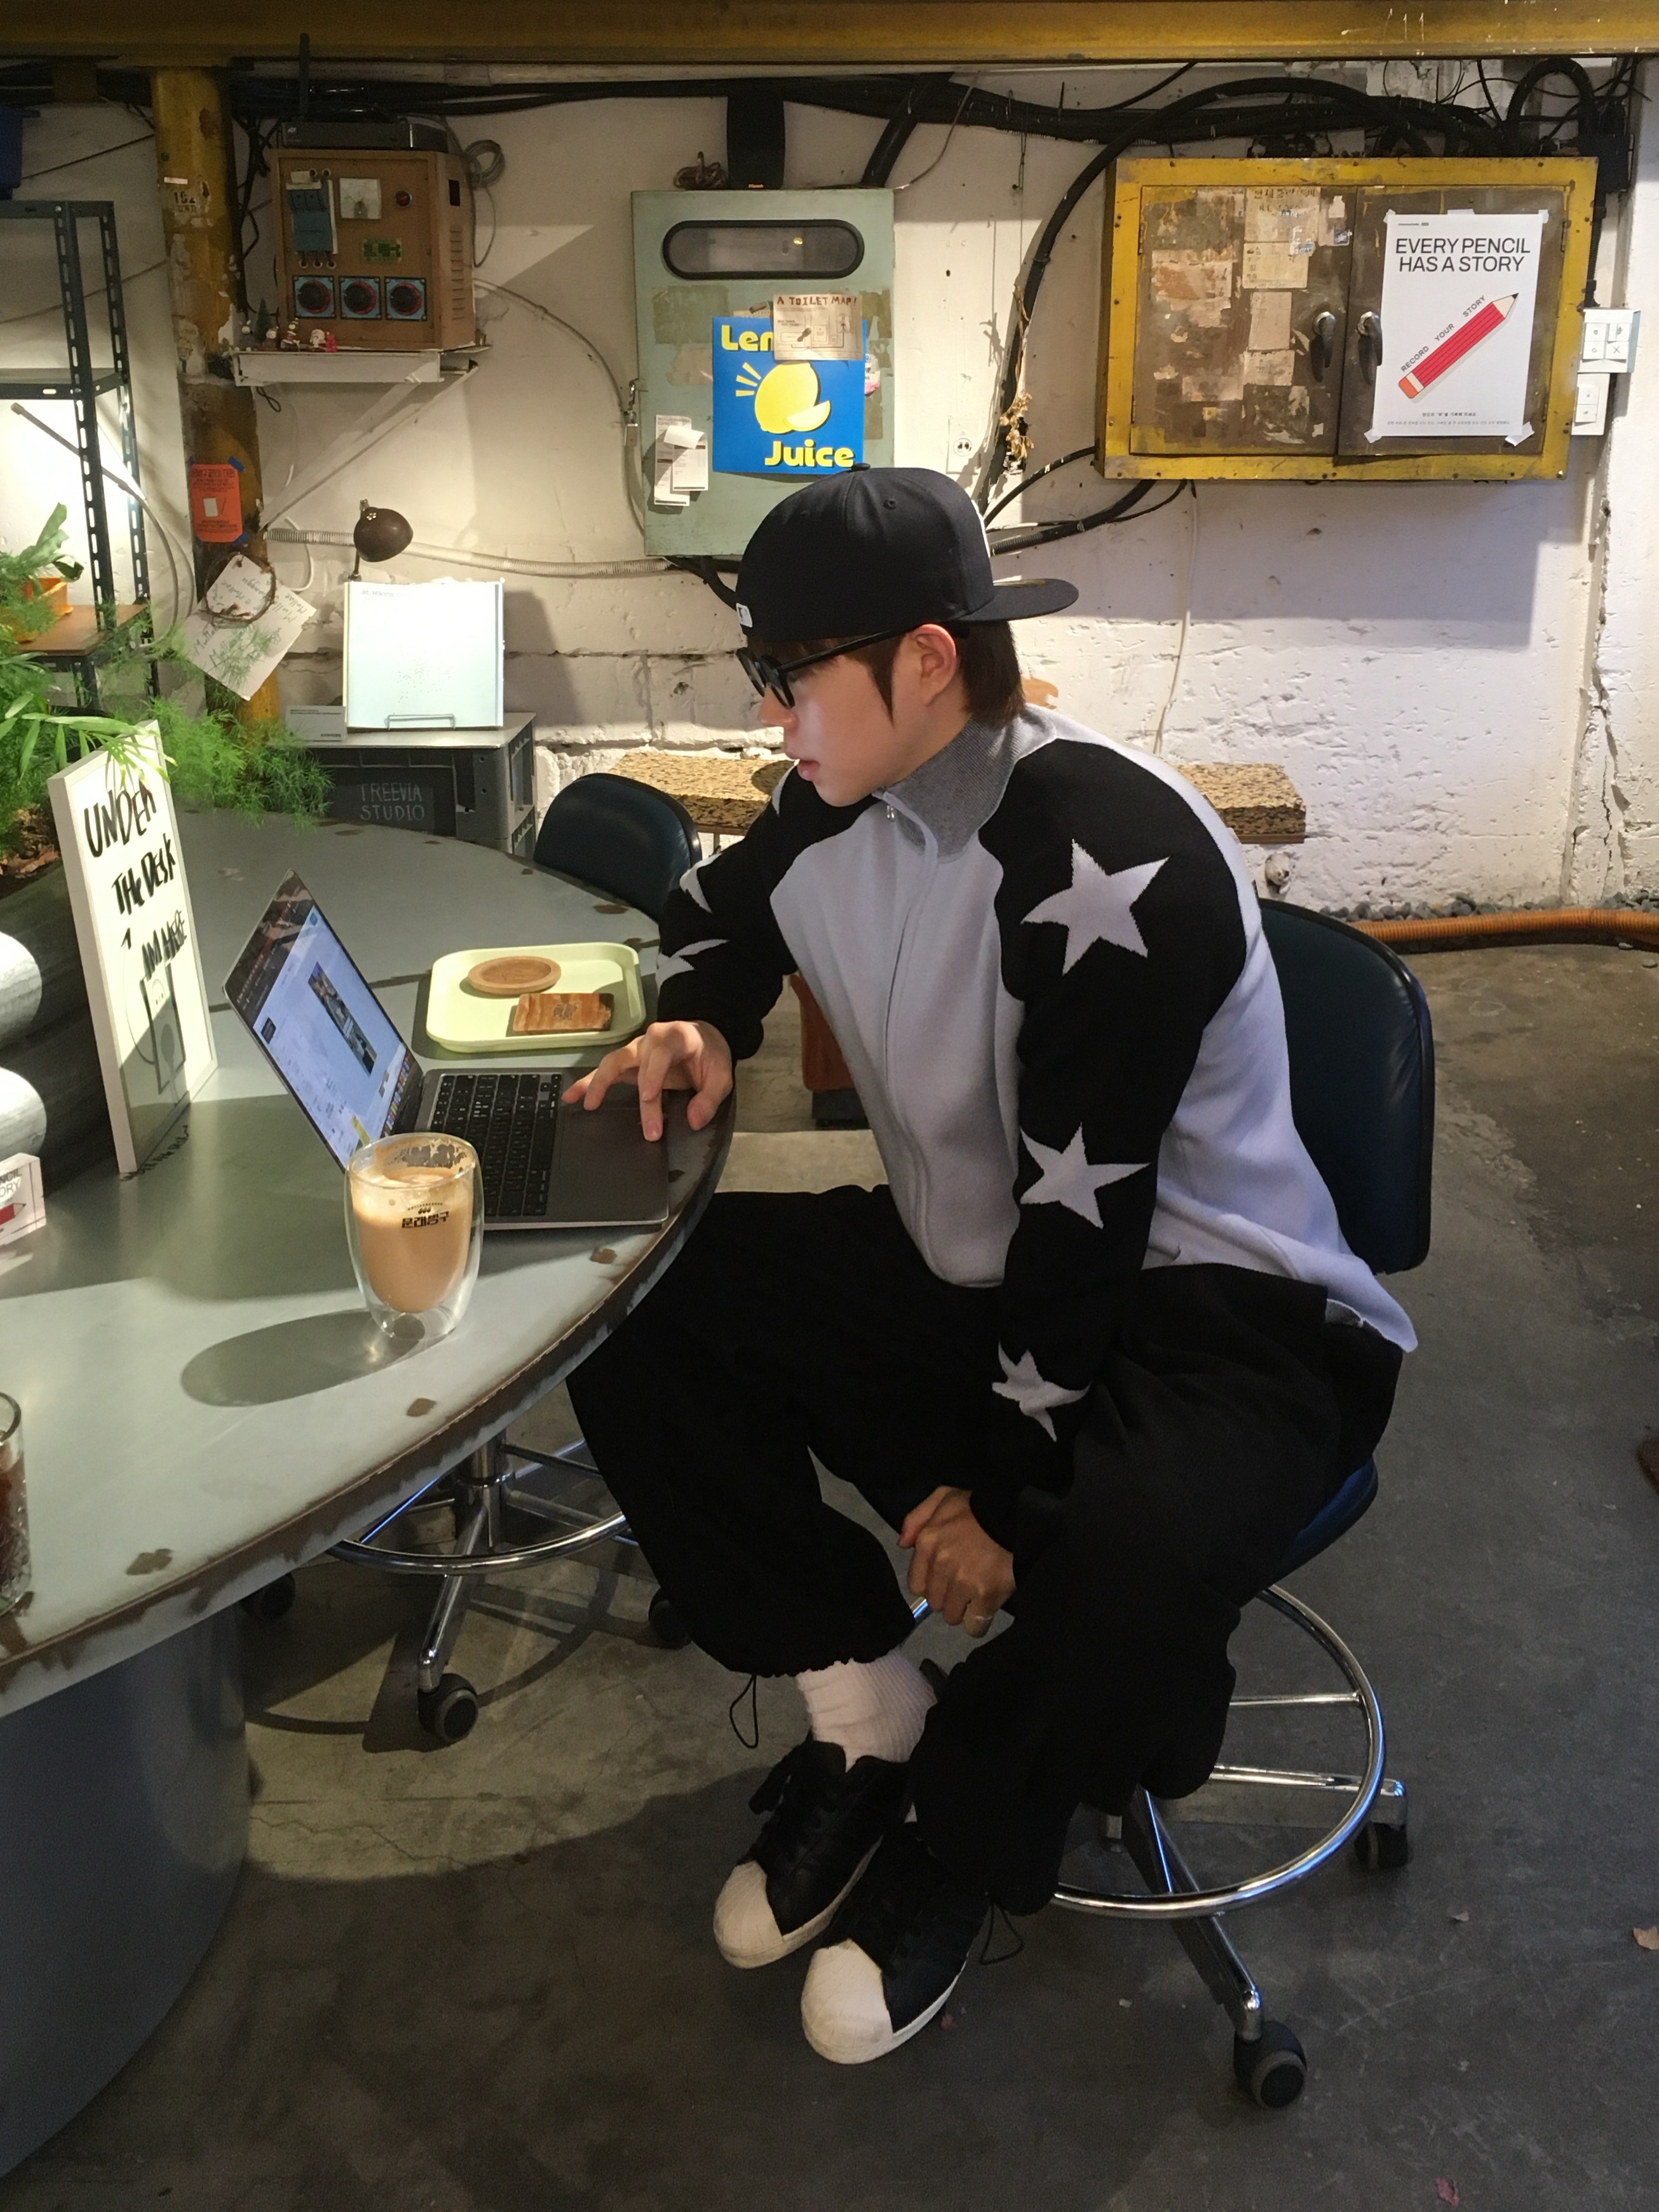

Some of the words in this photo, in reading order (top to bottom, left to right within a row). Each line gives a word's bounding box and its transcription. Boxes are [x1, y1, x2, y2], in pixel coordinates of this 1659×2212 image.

[1396, 238, 1459, 254] EVERY
[1461, 237, 1531, 254] PENCIL
[1399, 256, 1438, 273] HAS
[1441, 256, 1455, 272] A
[1459, 255, 1525, 272] STORY
[777, 296, 785, 306] A
[789, 296, 829, 306] TOILET
[1400, 346, 1430, 372] RECORD
[1434, 323, 1456, 343] YOUR
[1463, 295, 1486, 318] STORY
[764, 438, 856, 468] Juice
[360, 782, 423, 802] TREEVIA
[360, 804, 425, 821] STUDIO
